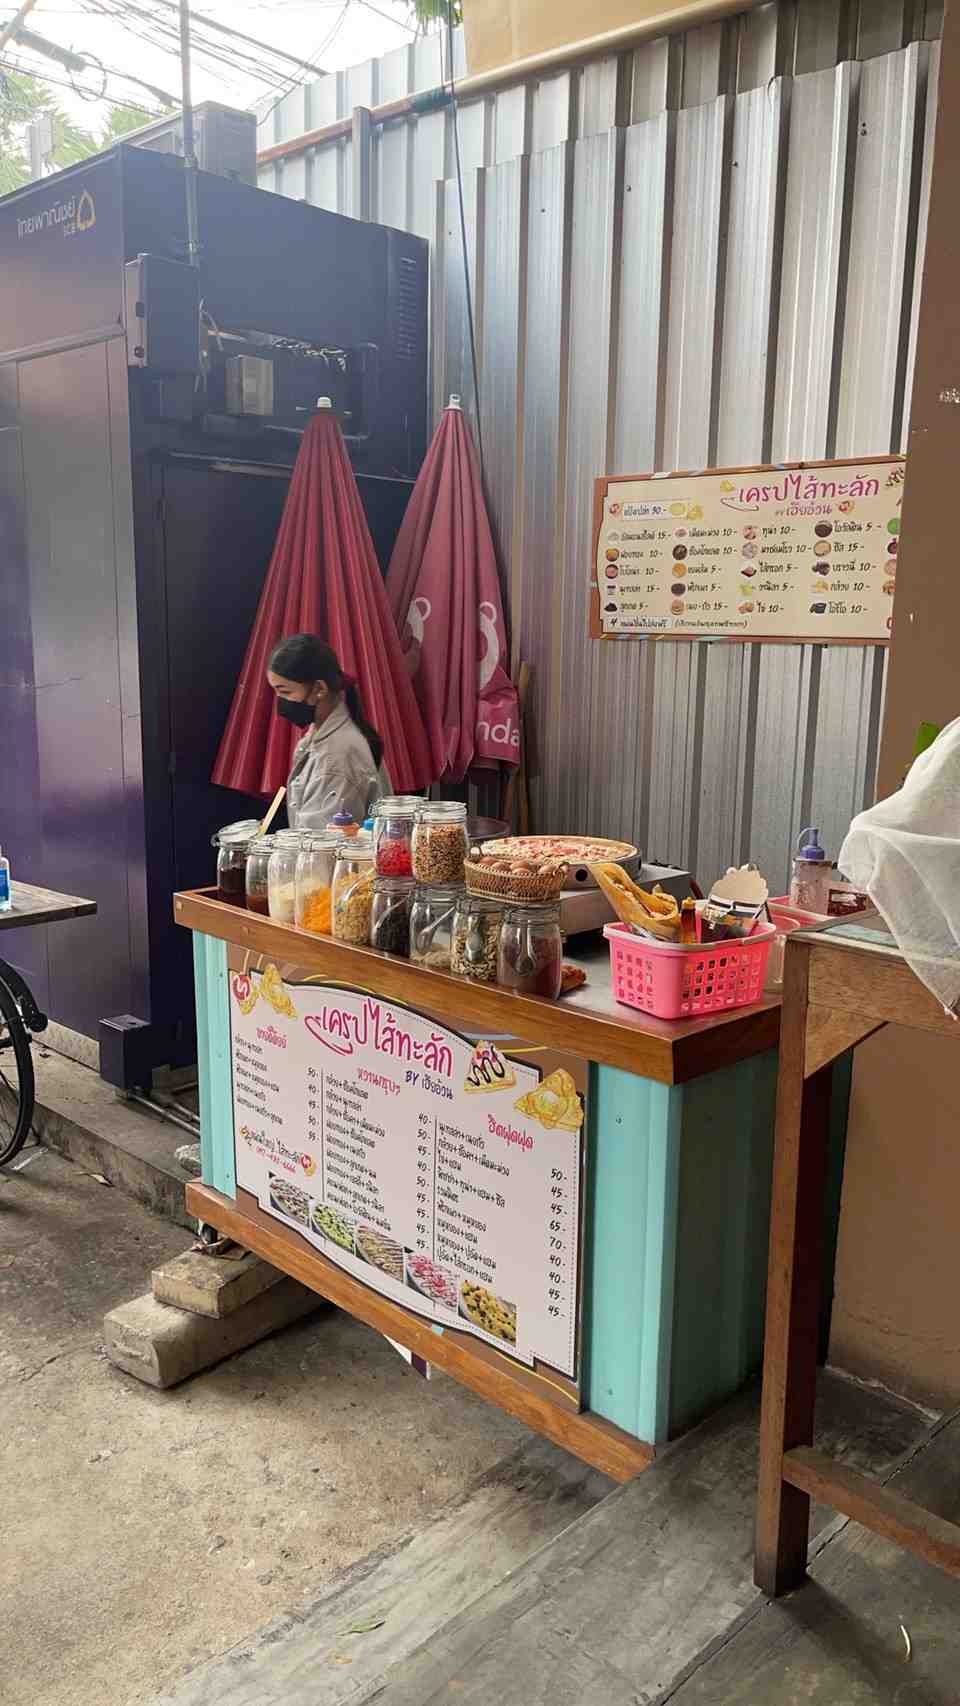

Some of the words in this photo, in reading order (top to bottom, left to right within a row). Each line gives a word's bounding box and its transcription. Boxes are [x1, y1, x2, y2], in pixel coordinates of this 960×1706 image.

[739, 473, 880, 503] เครปไส้ทะลัก
[323, 998, 453, 1078] เครปไส้ทะลัก
[405, 1070, 420, 1086] BY
